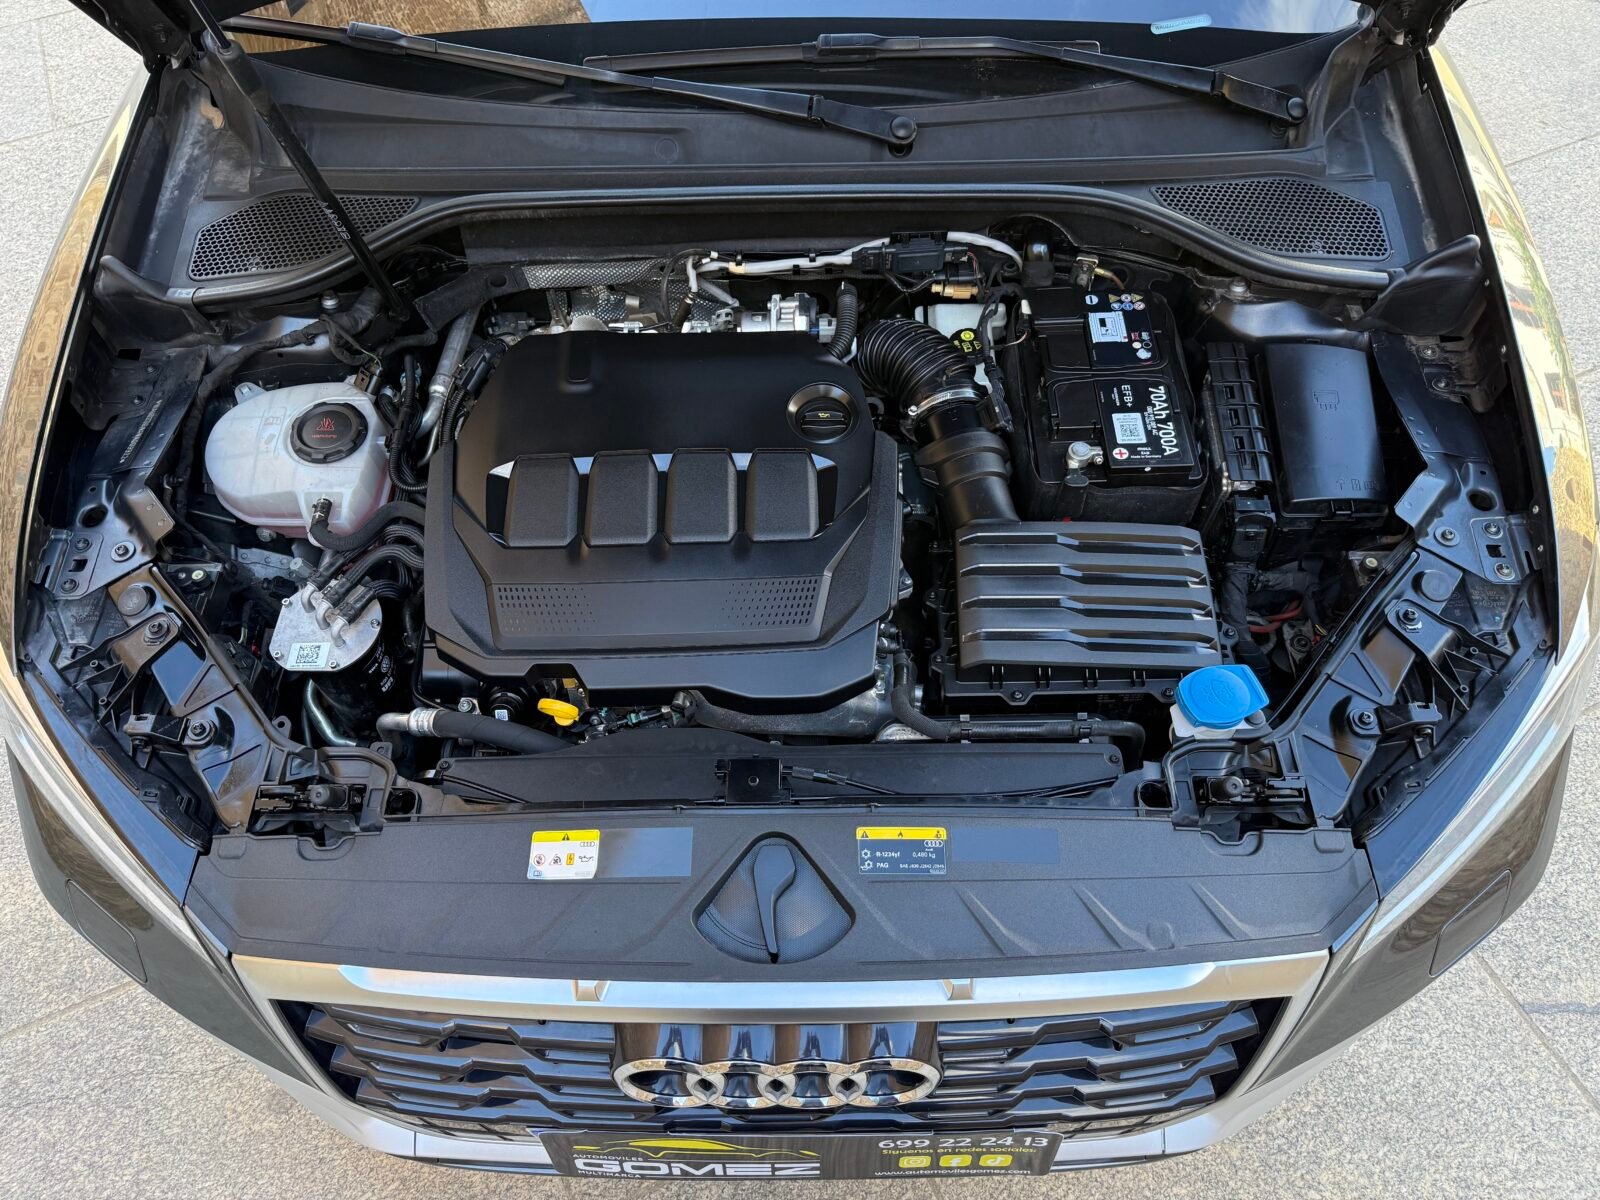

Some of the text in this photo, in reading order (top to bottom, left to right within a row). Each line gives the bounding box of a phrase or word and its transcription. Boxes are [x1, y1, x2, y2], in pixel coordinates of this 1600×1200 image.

[1121, 385, 1133, 407] EFB+
[1148, 386, 1170, 419] 70Ah
[1157, 422, 1180, 456] 700A
[928, 851, 936, 859] kg
[878, 1136, 1049, 1149] 699 22 24 13
[572, 1153, 644, 1162] AUTOMOVILES
[574, 1158, 821, 1176] GOMEZ
[577, 1170, 641, 1179] MULTIMARCA
